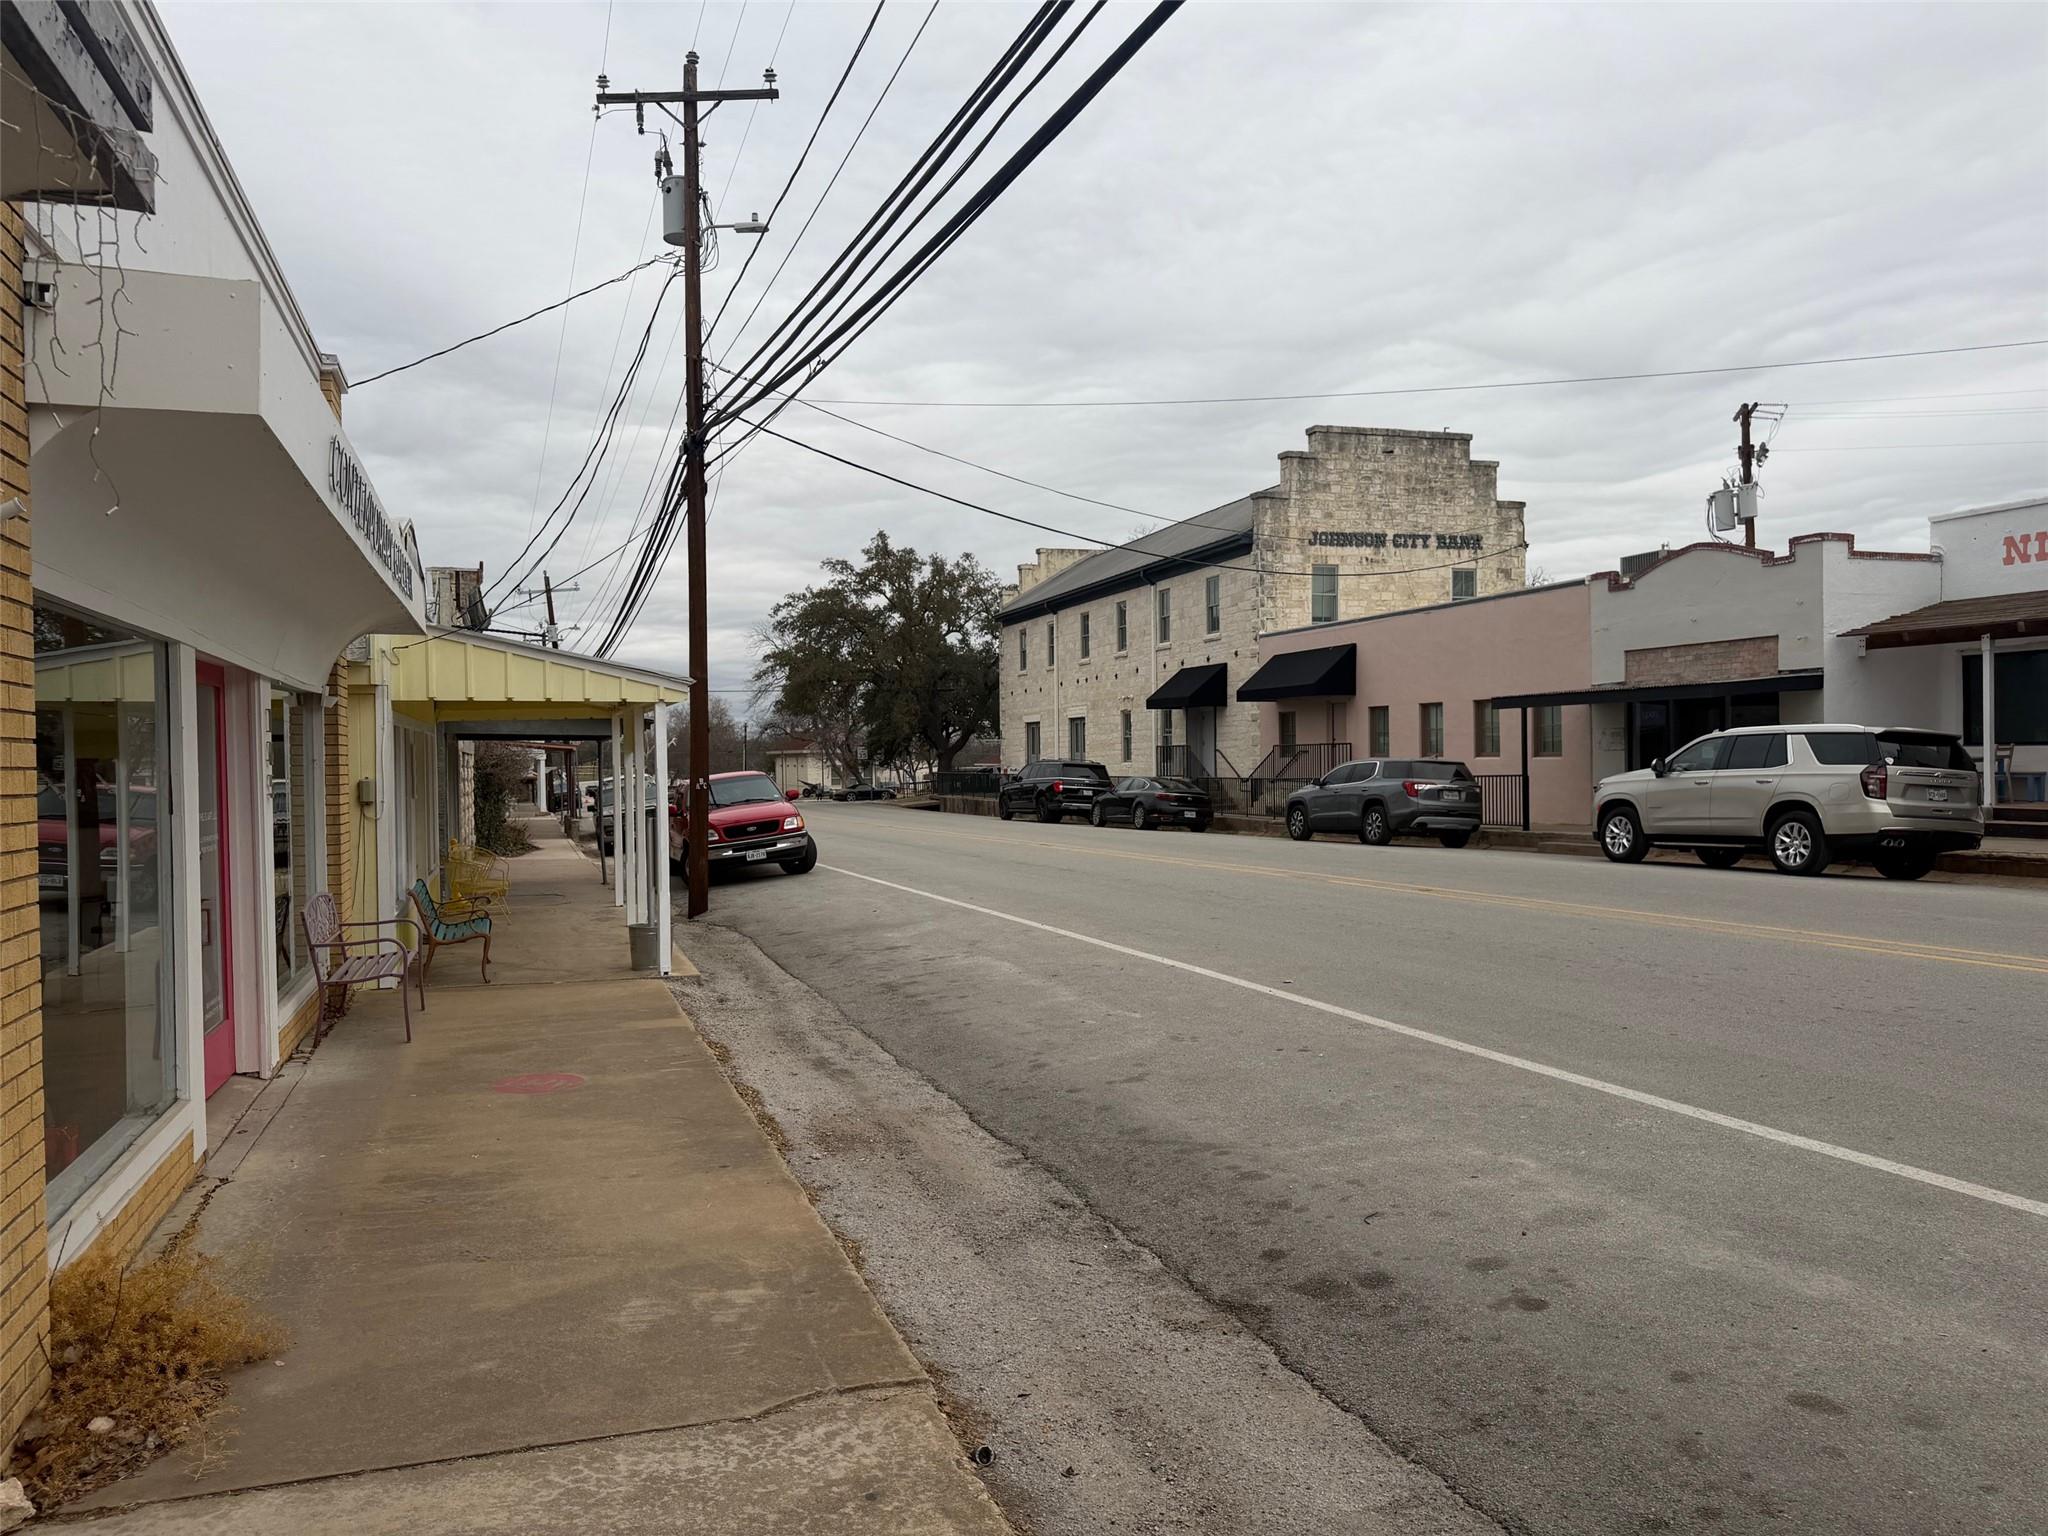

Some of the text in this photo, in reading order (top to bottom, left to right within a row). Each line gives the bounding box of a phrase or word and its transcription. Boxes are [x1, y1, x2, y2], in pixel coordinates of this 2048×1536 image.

[1308, 531, 1483, 550] JOHNSON CITY BANK
